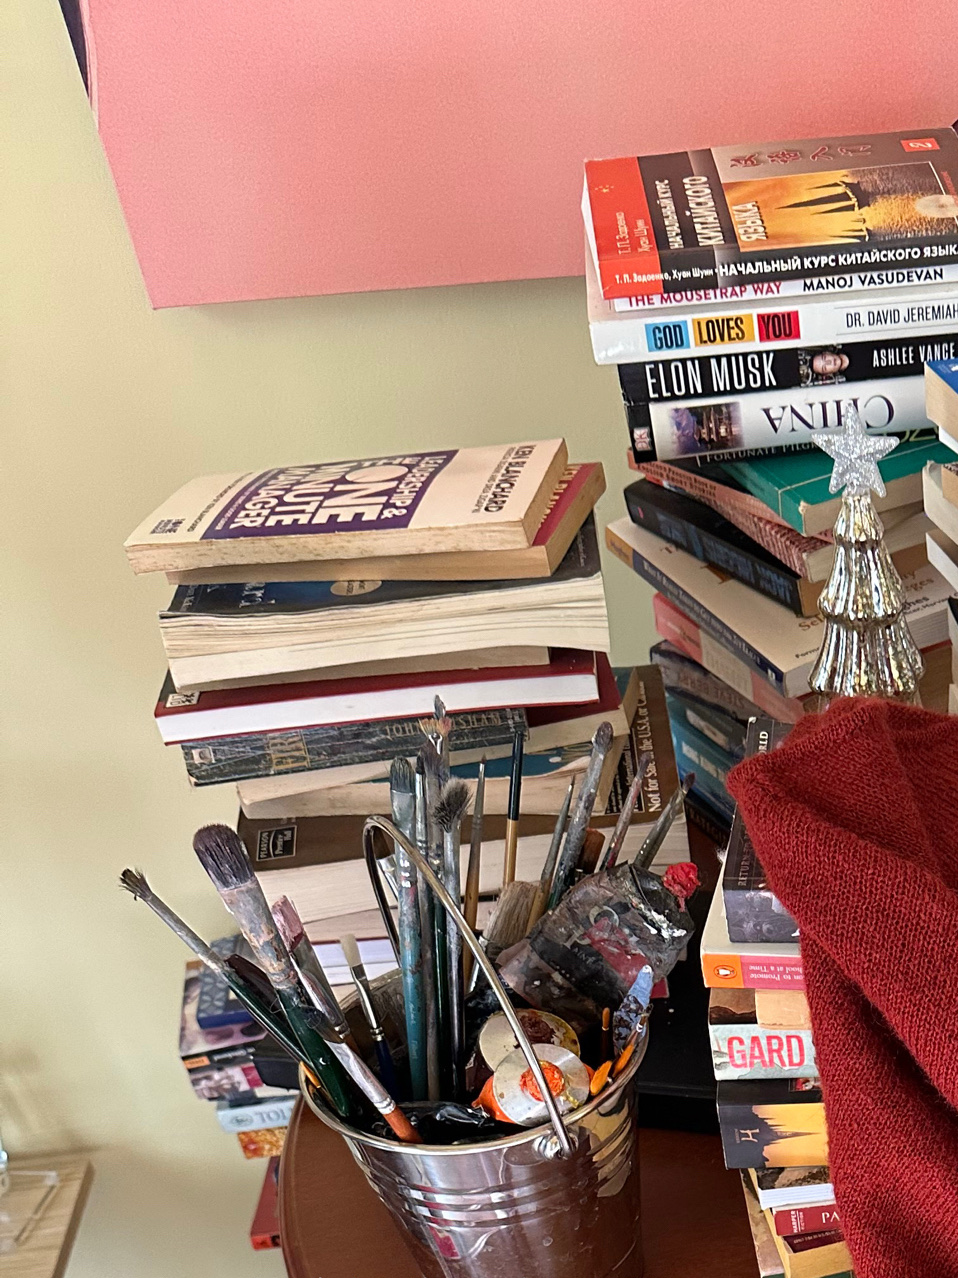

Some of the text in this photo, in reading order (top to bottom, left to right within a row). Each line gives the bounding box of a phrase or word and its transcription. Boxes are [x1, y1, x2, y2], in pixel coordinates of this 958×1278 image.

[682, 175, 725, 246] КИТАЙСКОГО
[732, 201, 768, 242] ЯЗЫКА
[719, 255, 801, 277] НАЧАЛЬНЫЙ
[803, 253, 836, 269] КУРС
[838, 247, 921, 266] КИТАЙСКОГО
[627, 267, 944, 307] THE MOUSETRAP WAY MANOJ VASUDEVAN
[652, 323, 684, 349] GOD
[699, 318, 745, 345] LOVES
[761, 314, 793, 339] YOU
[846, 313, 866, 329] DR.
[867, 309, 900, 327] DAVID
[645, 341, 956, 399] ELON MUSK ASHLEE VANCE
[761, 394, 895, 433] CHINA
[514, 445, 537, 460] KEN
[706, 444, 778, 463] FORTUNATE
[229, 468, 317, 532] MANAGER
[264, 462, 355, 527] MINUTE
[310, 468, 408, 522] ONE
[380, 457, 446, 522] LEADERSHIP &
[483, 457, 524, 514] BLANCHARD
[640, 737, 662, 813] Not for the
[726, 1034, 807, 1070] GARD
[790, 1209, 798, 1234] HARPER
